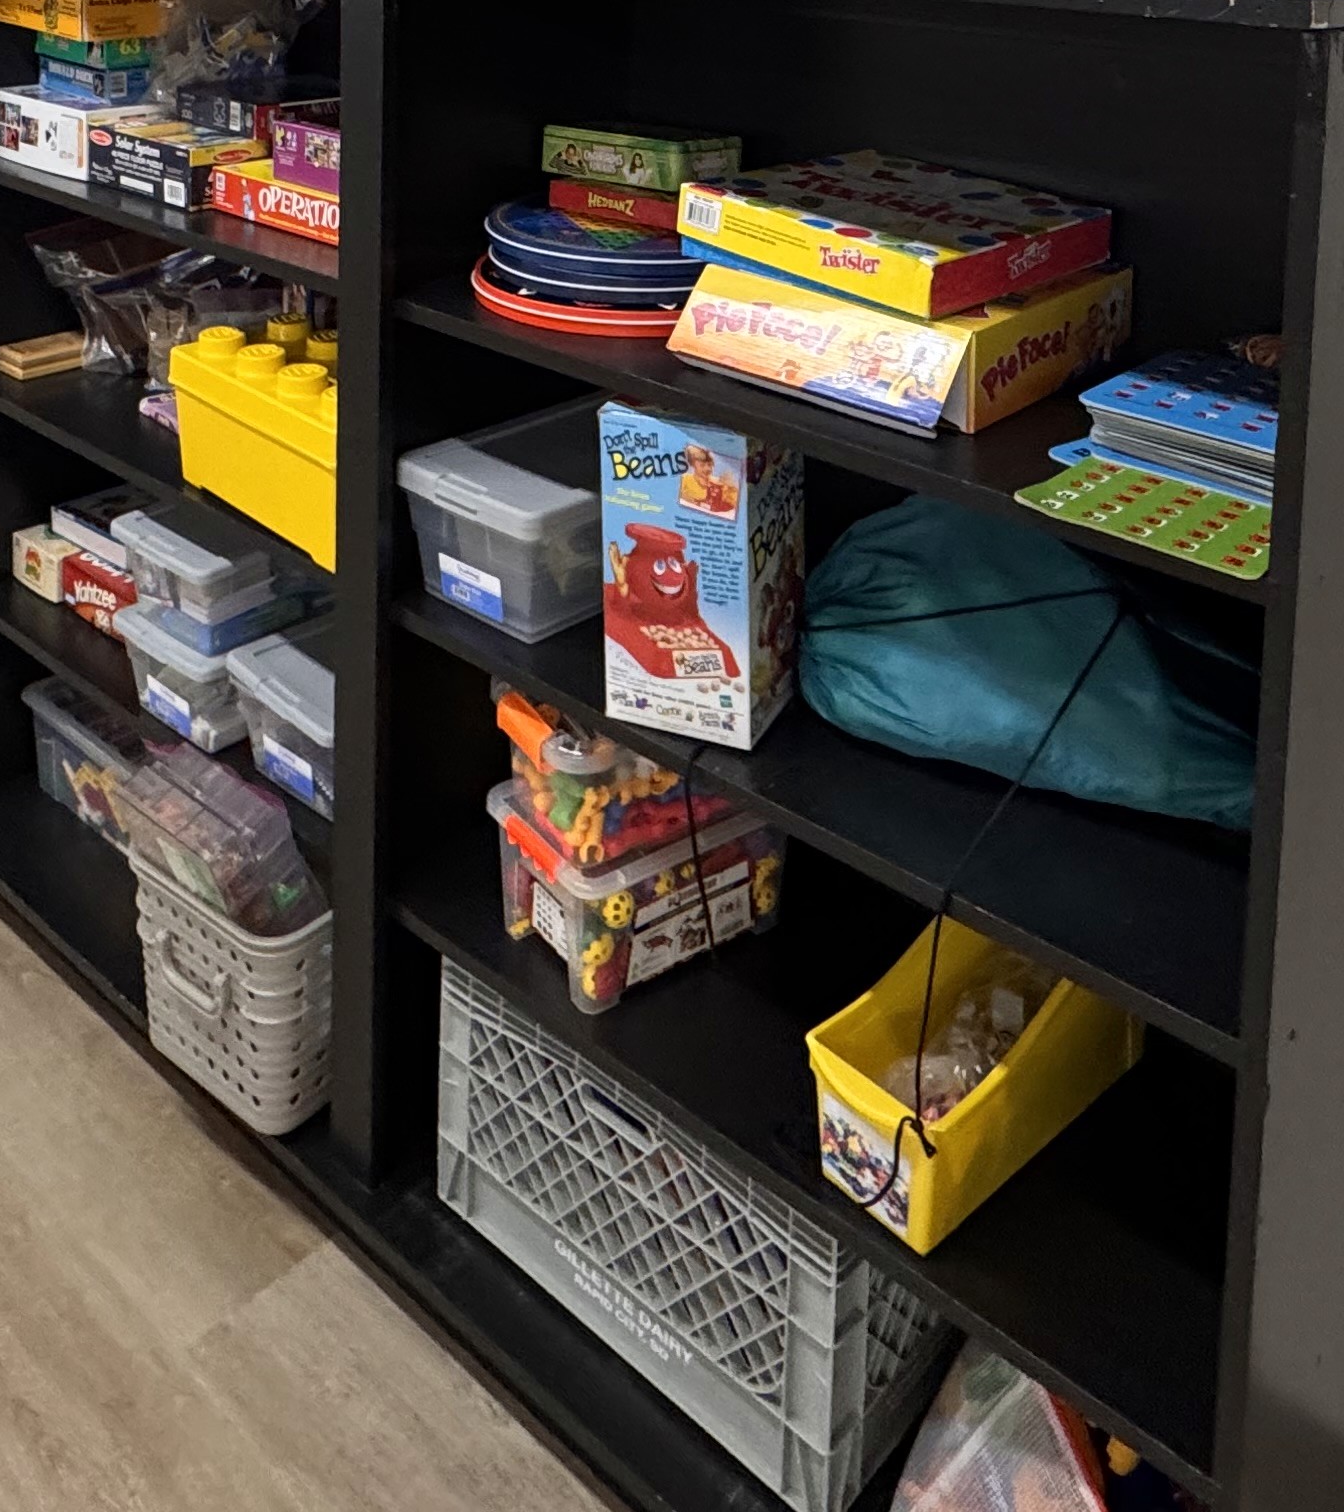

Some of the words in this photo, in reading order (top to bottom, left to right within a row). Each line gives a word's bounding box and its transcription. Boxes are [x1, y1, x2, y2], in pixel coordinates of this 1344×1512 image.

[258, 186, 340, 230] OPERATIO
[819, 245, 881, 274] Twister
[633, 432, 659, 452] Spill
[607, 450, 690, 481] Beans
[73, 579, 117, 612] Yahtzee
[554, 1239, 634, 1317] GILLETTE
[638, 1309, 694, 1365] DAIRY
